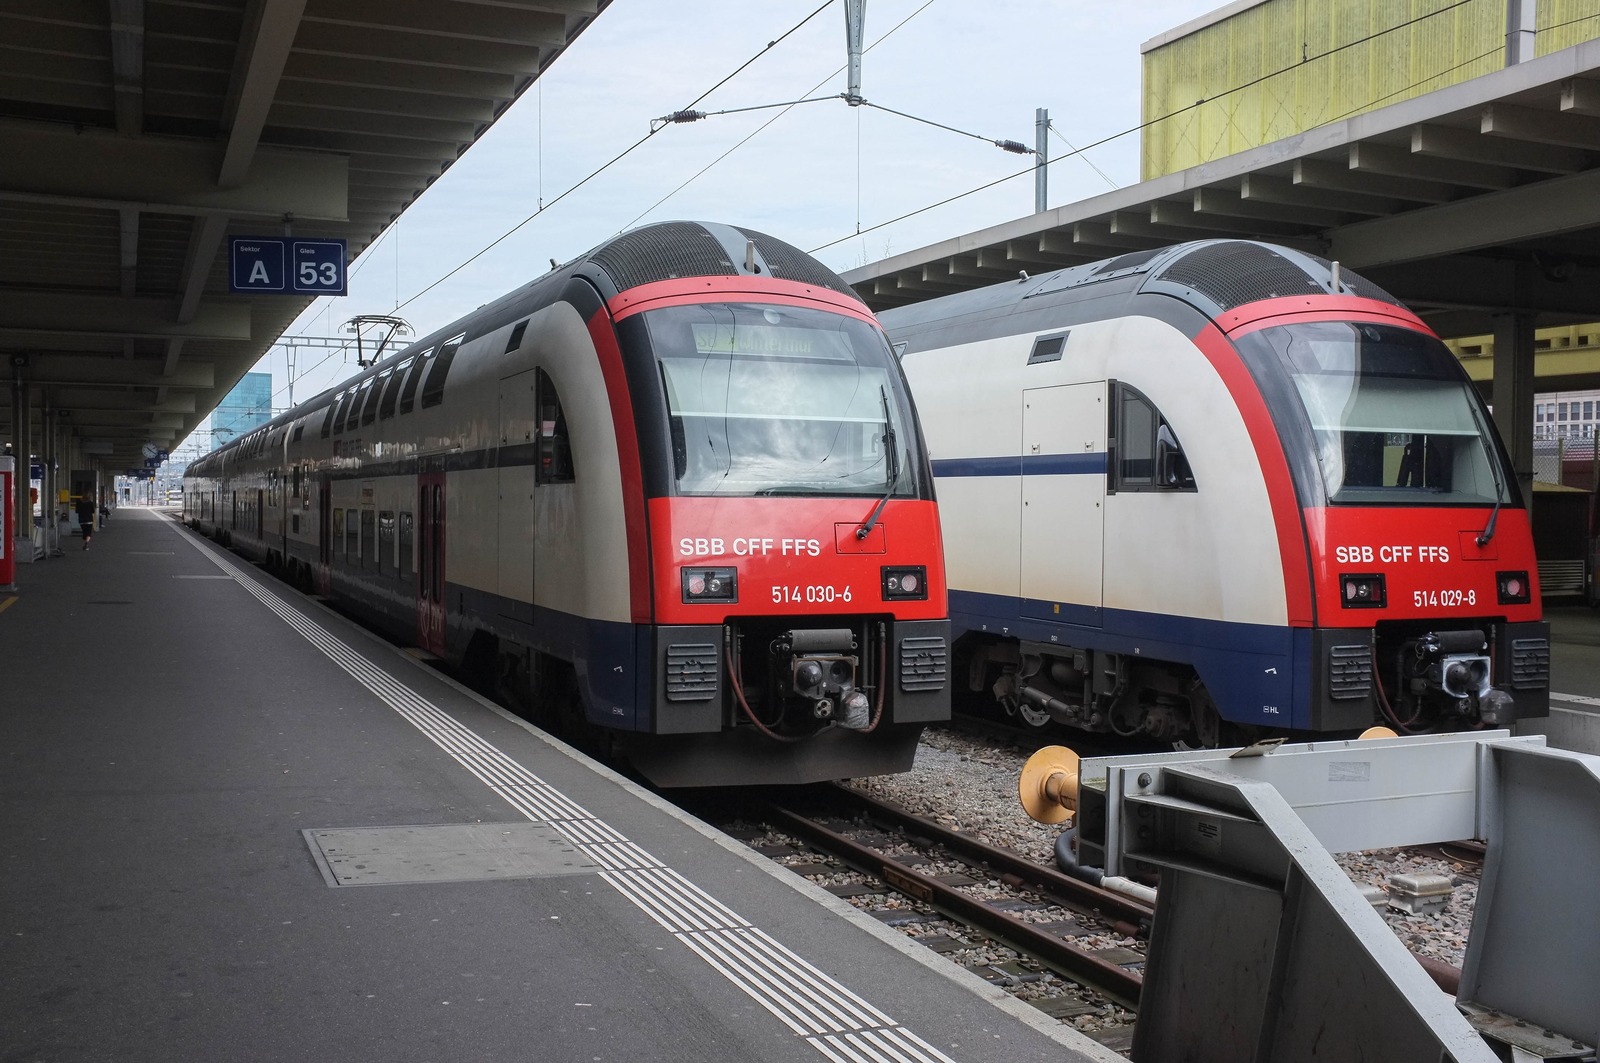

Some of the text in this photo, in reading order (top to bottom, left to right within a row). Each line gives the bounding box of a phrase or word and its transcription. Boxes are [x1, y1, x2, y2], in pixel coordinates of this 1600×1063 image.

[248, 260, 270, 284] A
[299, 262, 337, 286] 53
[679, 537, 821, 557] SBB CFF FFS
[1335, 545, 1450, 563] SBB CFF FFS
[771, 585, 852, 603] 514 030-6
[1413, 589, 1476, 607] 514 029-8
[1269, 706, 1280, 714] HL
